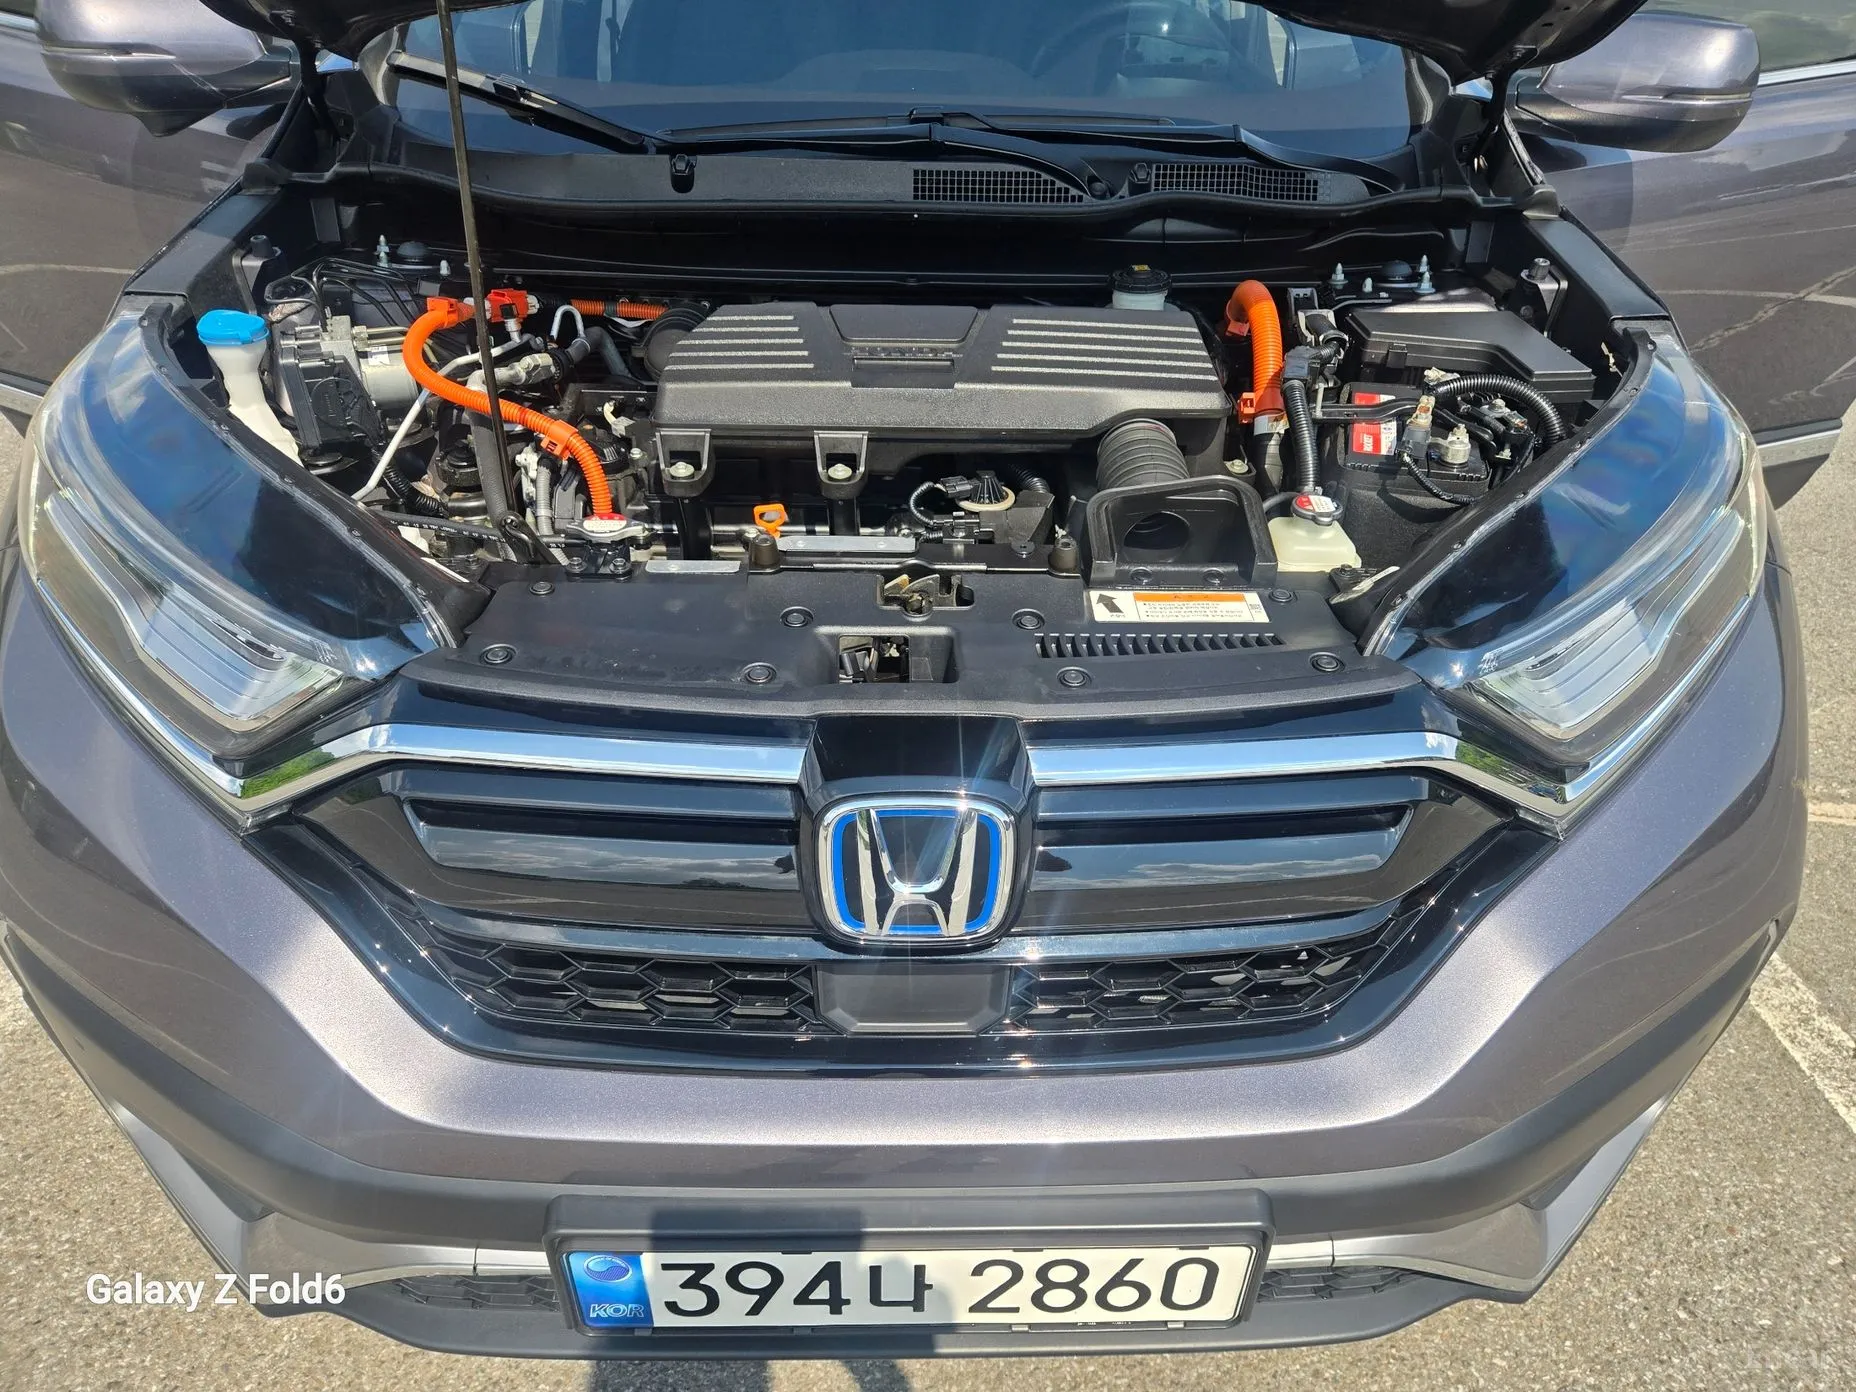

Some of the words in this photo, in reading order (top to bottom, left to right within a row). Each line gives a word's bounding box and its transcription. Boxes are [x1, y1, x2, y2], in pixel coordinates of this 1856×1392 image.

[661, 1261, 933, 1317] 394나
[968, 1257, 1219, 1313] 2860
[589, 1303, 645, 1318] KOR
